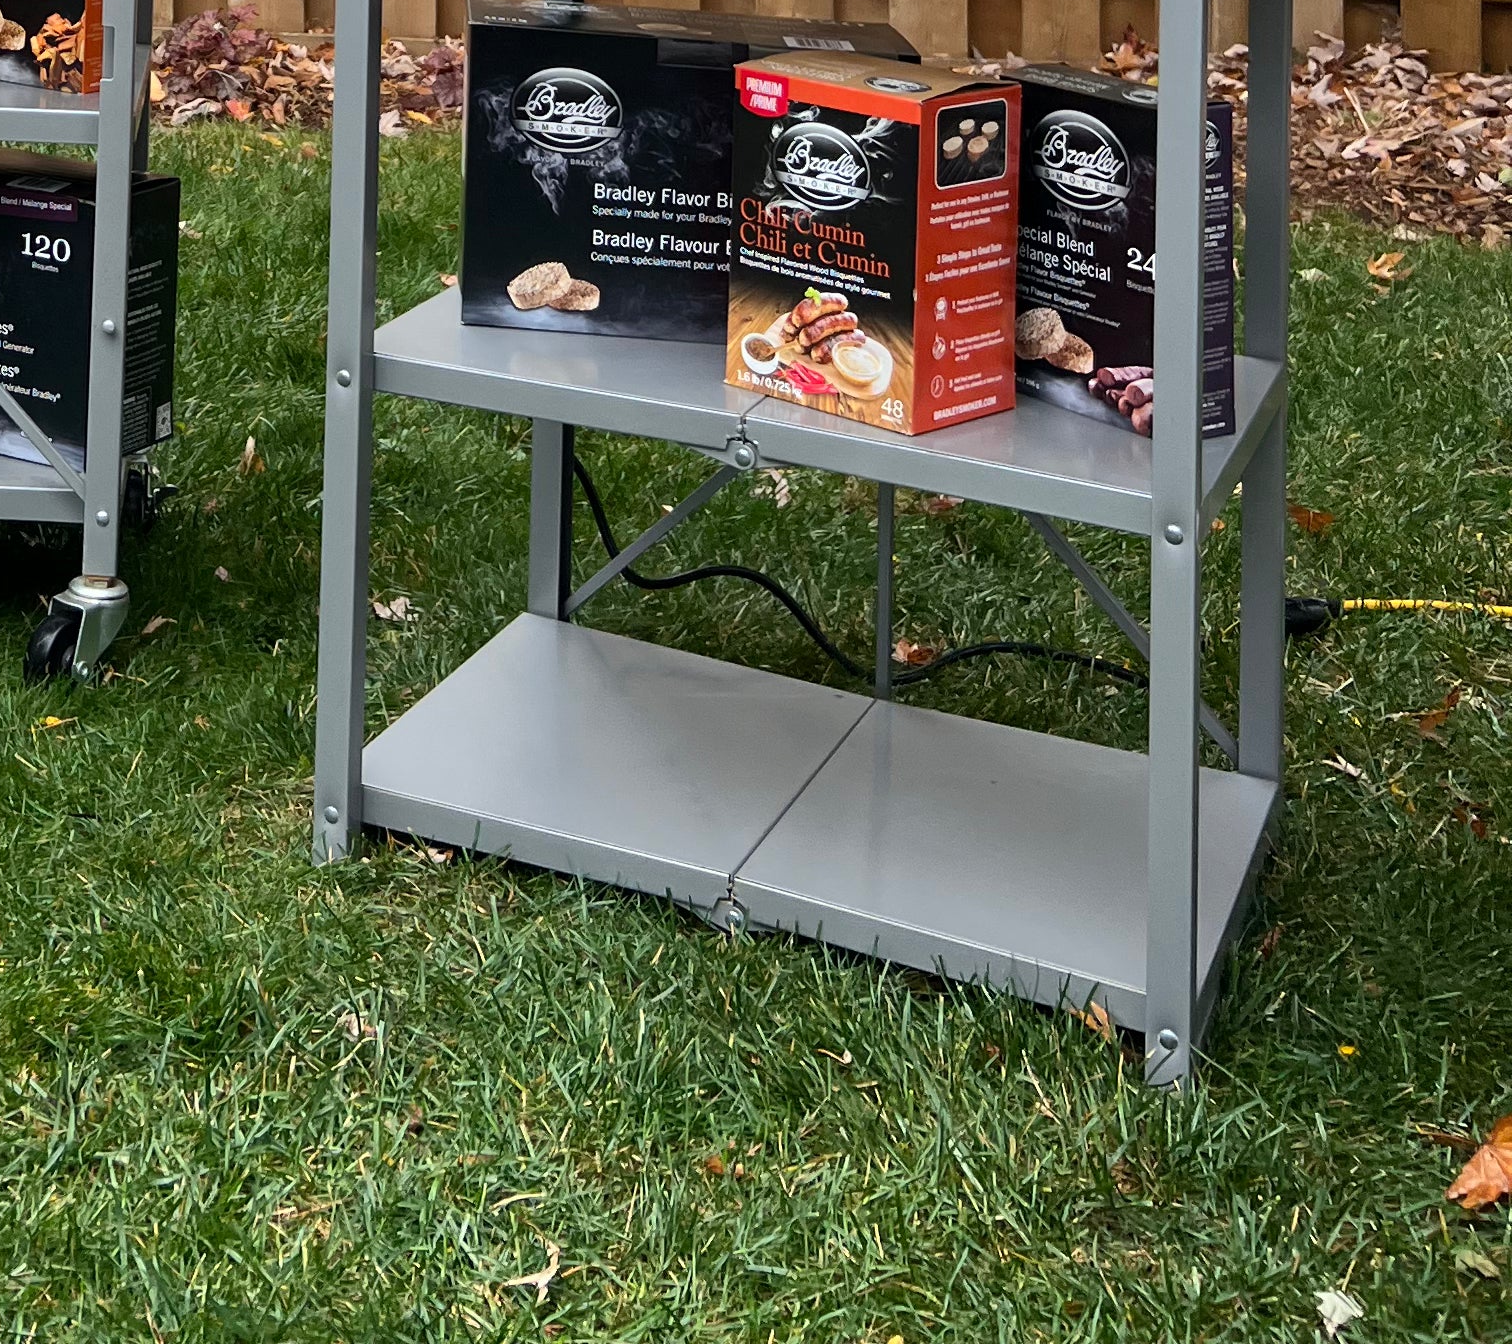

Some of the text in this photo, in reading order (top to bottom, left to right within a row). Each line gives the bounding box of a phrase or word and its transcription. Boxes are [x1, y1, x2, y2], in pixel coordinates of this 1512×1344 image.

[745, 77, 782, 97] PREMIUM
[517, 82, 617, 124] Bradley
[570, 158, 605, 167] BRADLEY
[777, 137, 865, 183] Bradley
[1034, 125, 1124, 182] Bradley
[594, 183, 655, 206] Bradley
[661, 188, 710, 207] Flavor
[592, 205, 732, 226] Specially made for your Bradley
[740, 197, 788, 229] Chili
[793, 211, 865, 247] Cumin
[21, 232, 71, 262] 120
[592, 229, 654, 253] Bradley
[659, 234, 720, 254] Flavour
[740, 222, 787, 253] Chili
[793, 242, 812, 260] et
[817, 241, 891, 278] Cumin
[1017, 224, 1094, 257] pecial Blend
[590, 251, 630, 265] Conçues
[631, 255, 691, 269] spécialement
[693, 261, 715, 271] pour
[1019, 243, 1059, 268] élange
[1063, 255, 1111, 282] Spécial
[1127, 247, 1156, 280] 24
[2, 340, 35, 355] Generator
[880, 397, 904, 419] 48
